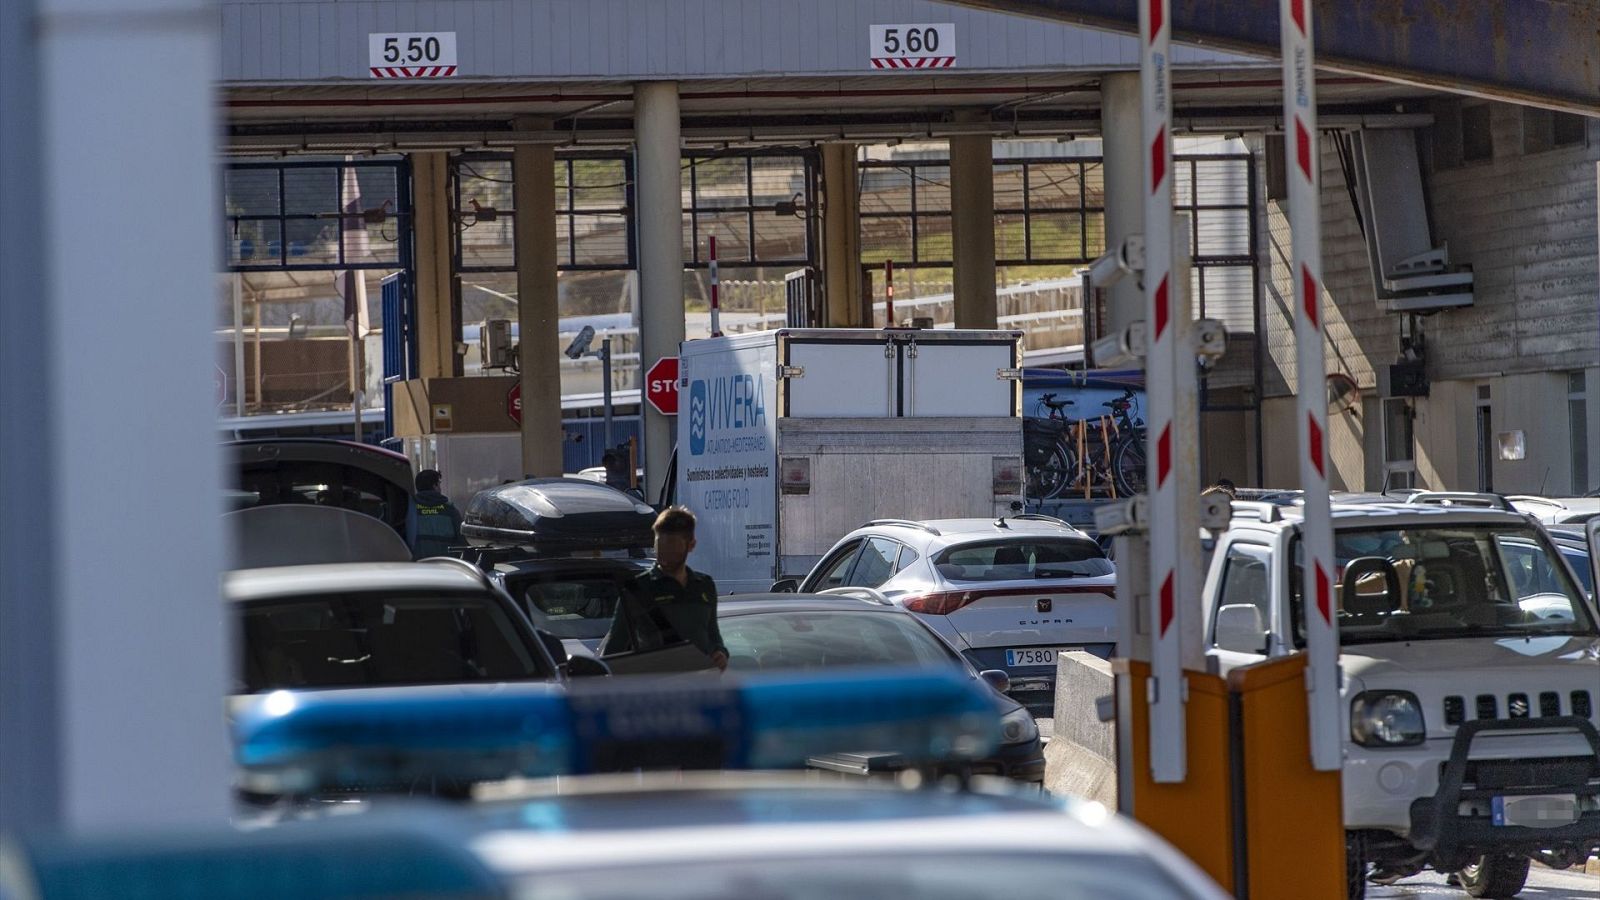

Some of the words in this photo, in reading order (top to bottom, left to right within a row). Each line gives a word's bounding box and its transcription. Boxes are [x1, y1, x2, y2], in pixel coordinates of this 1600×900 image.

[383, 36, 440, 65] 5,50
[884, 27, 939, 56] 5,60
[707, 373, 766, 430] VIVERA
[704, 489, 732, 510] CATERING
[732, 487, 749, 509] FOD
[1019, 618, 1073, 626] CUPRA
[1016, 650, 1052, 664] 7580
